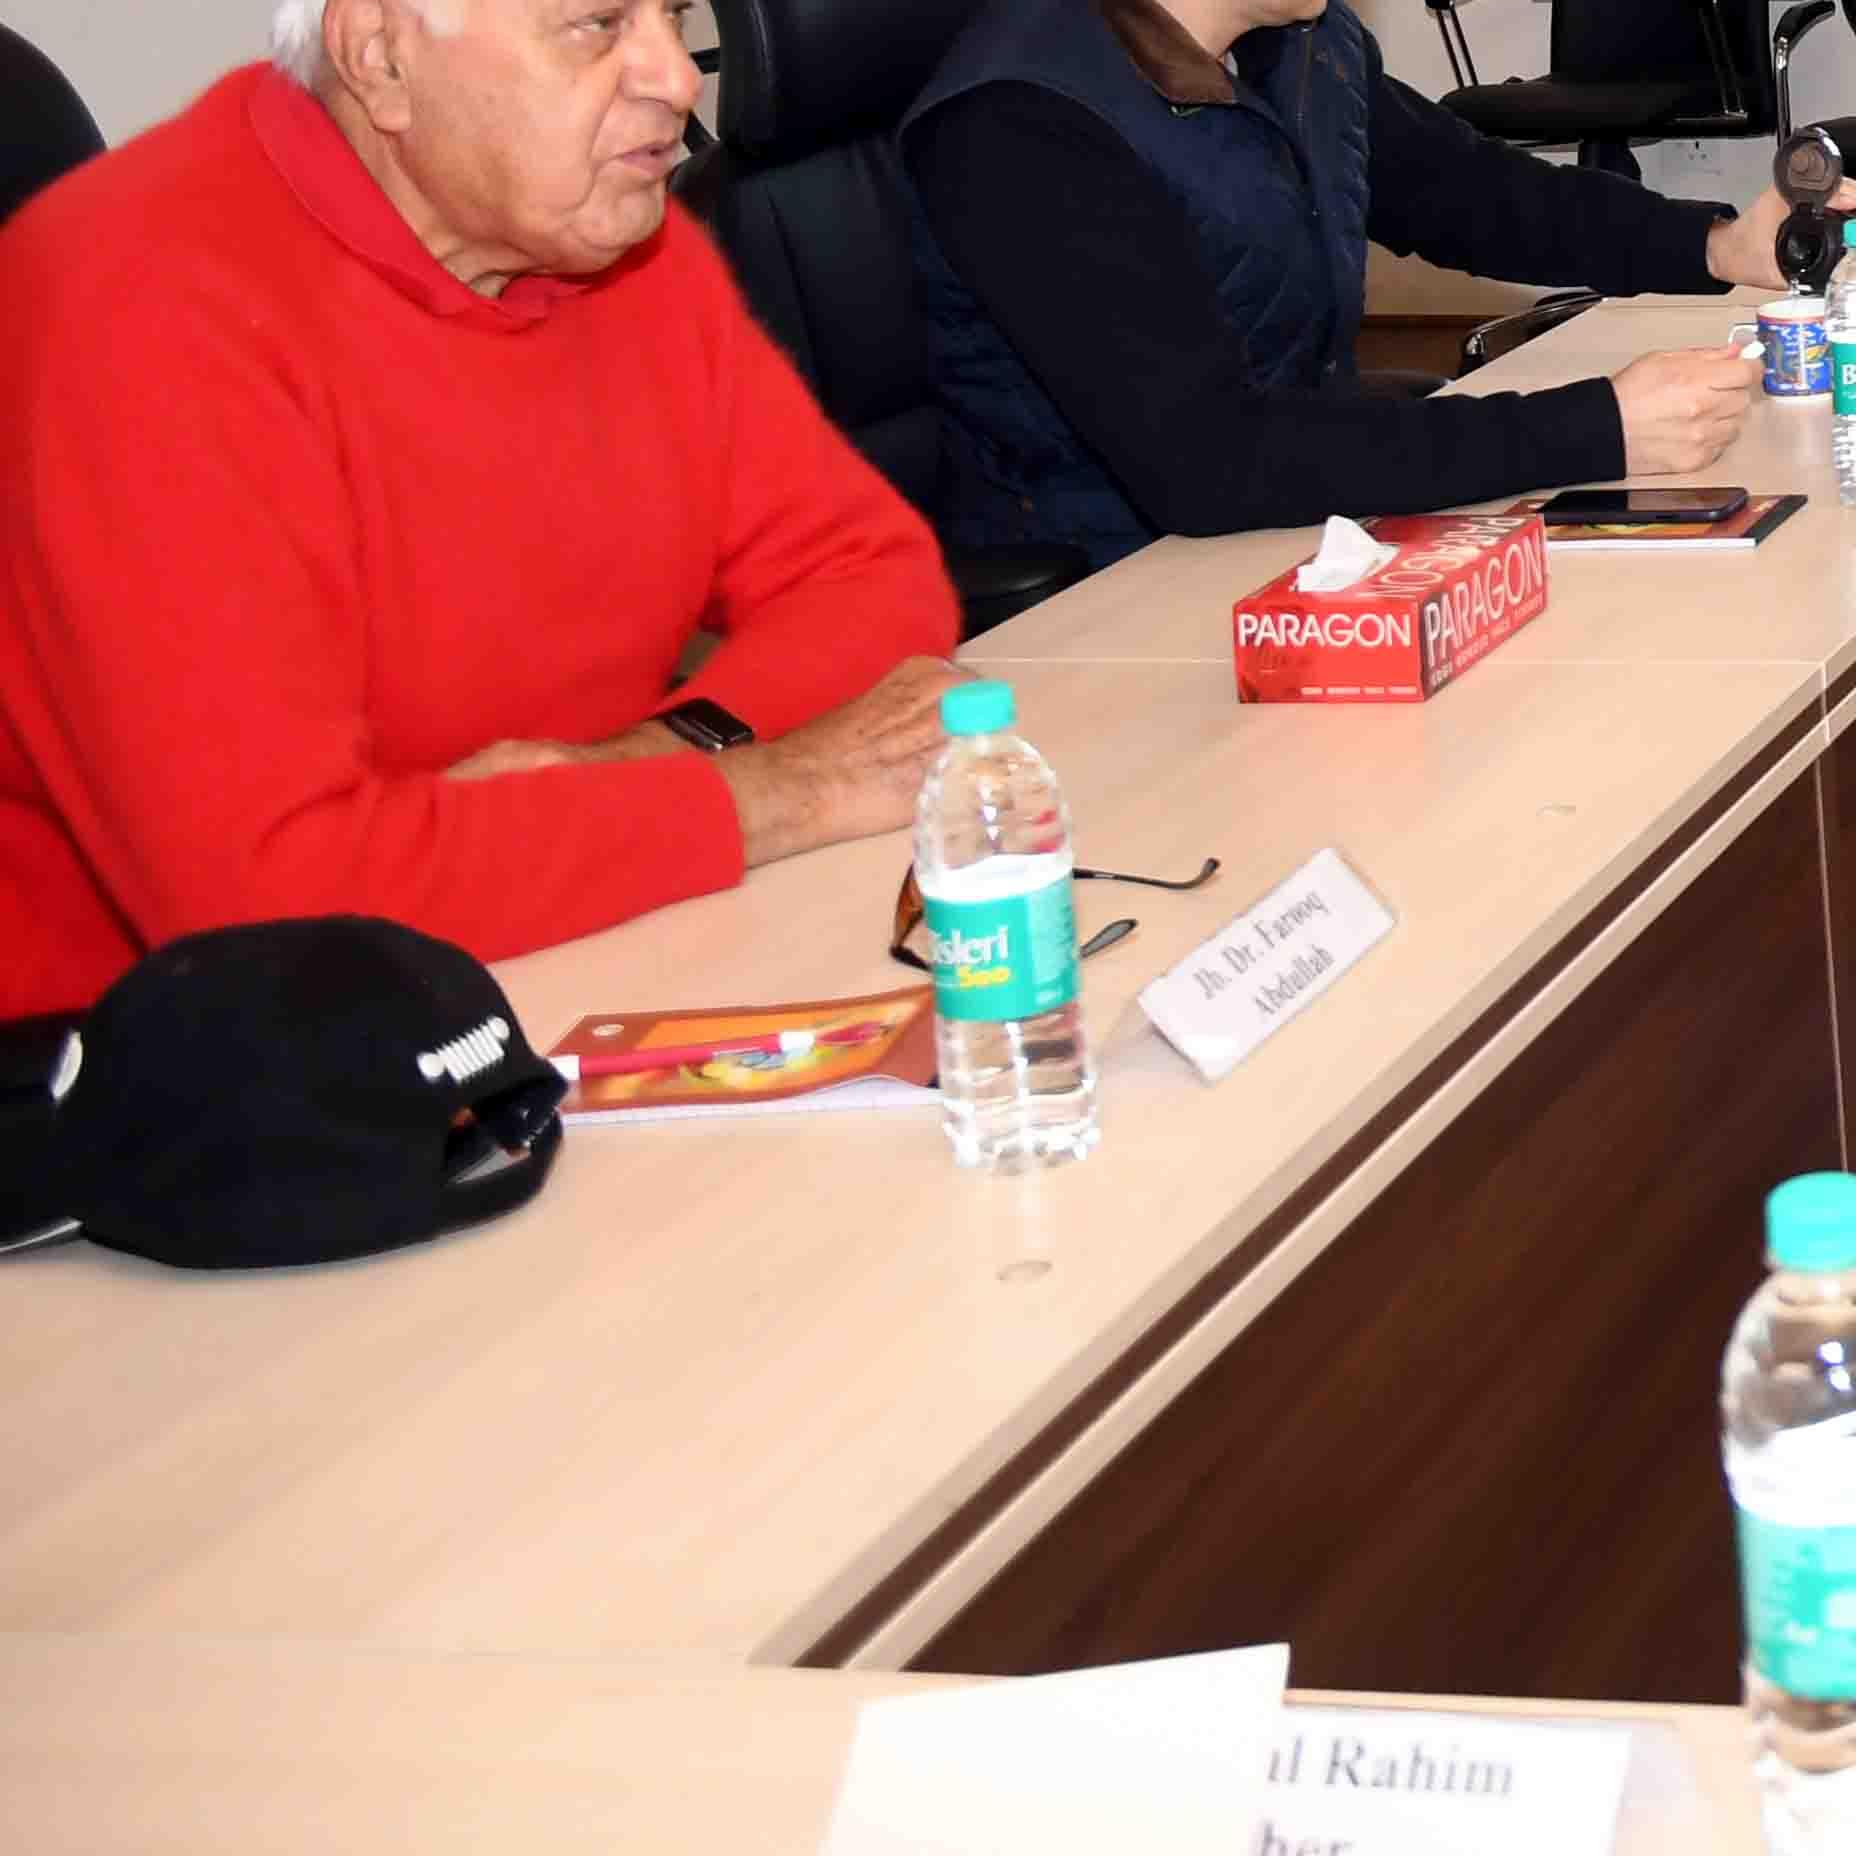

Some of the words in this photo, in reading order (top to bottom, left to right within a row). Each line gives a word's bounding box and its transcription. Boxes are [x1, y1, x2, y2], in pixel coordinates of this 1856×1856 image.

[1238, 614, 1411, 647] PARAGON
[1424, 528, 1543, 668] PARAGON
[1221, 944, 1265, 974] Dr.
[1253, 891, 1332, 948] Farooq
[1255, 944, 1335, 1015] Abdullah
[1324, 1735, 1516, 1797] Rahim
